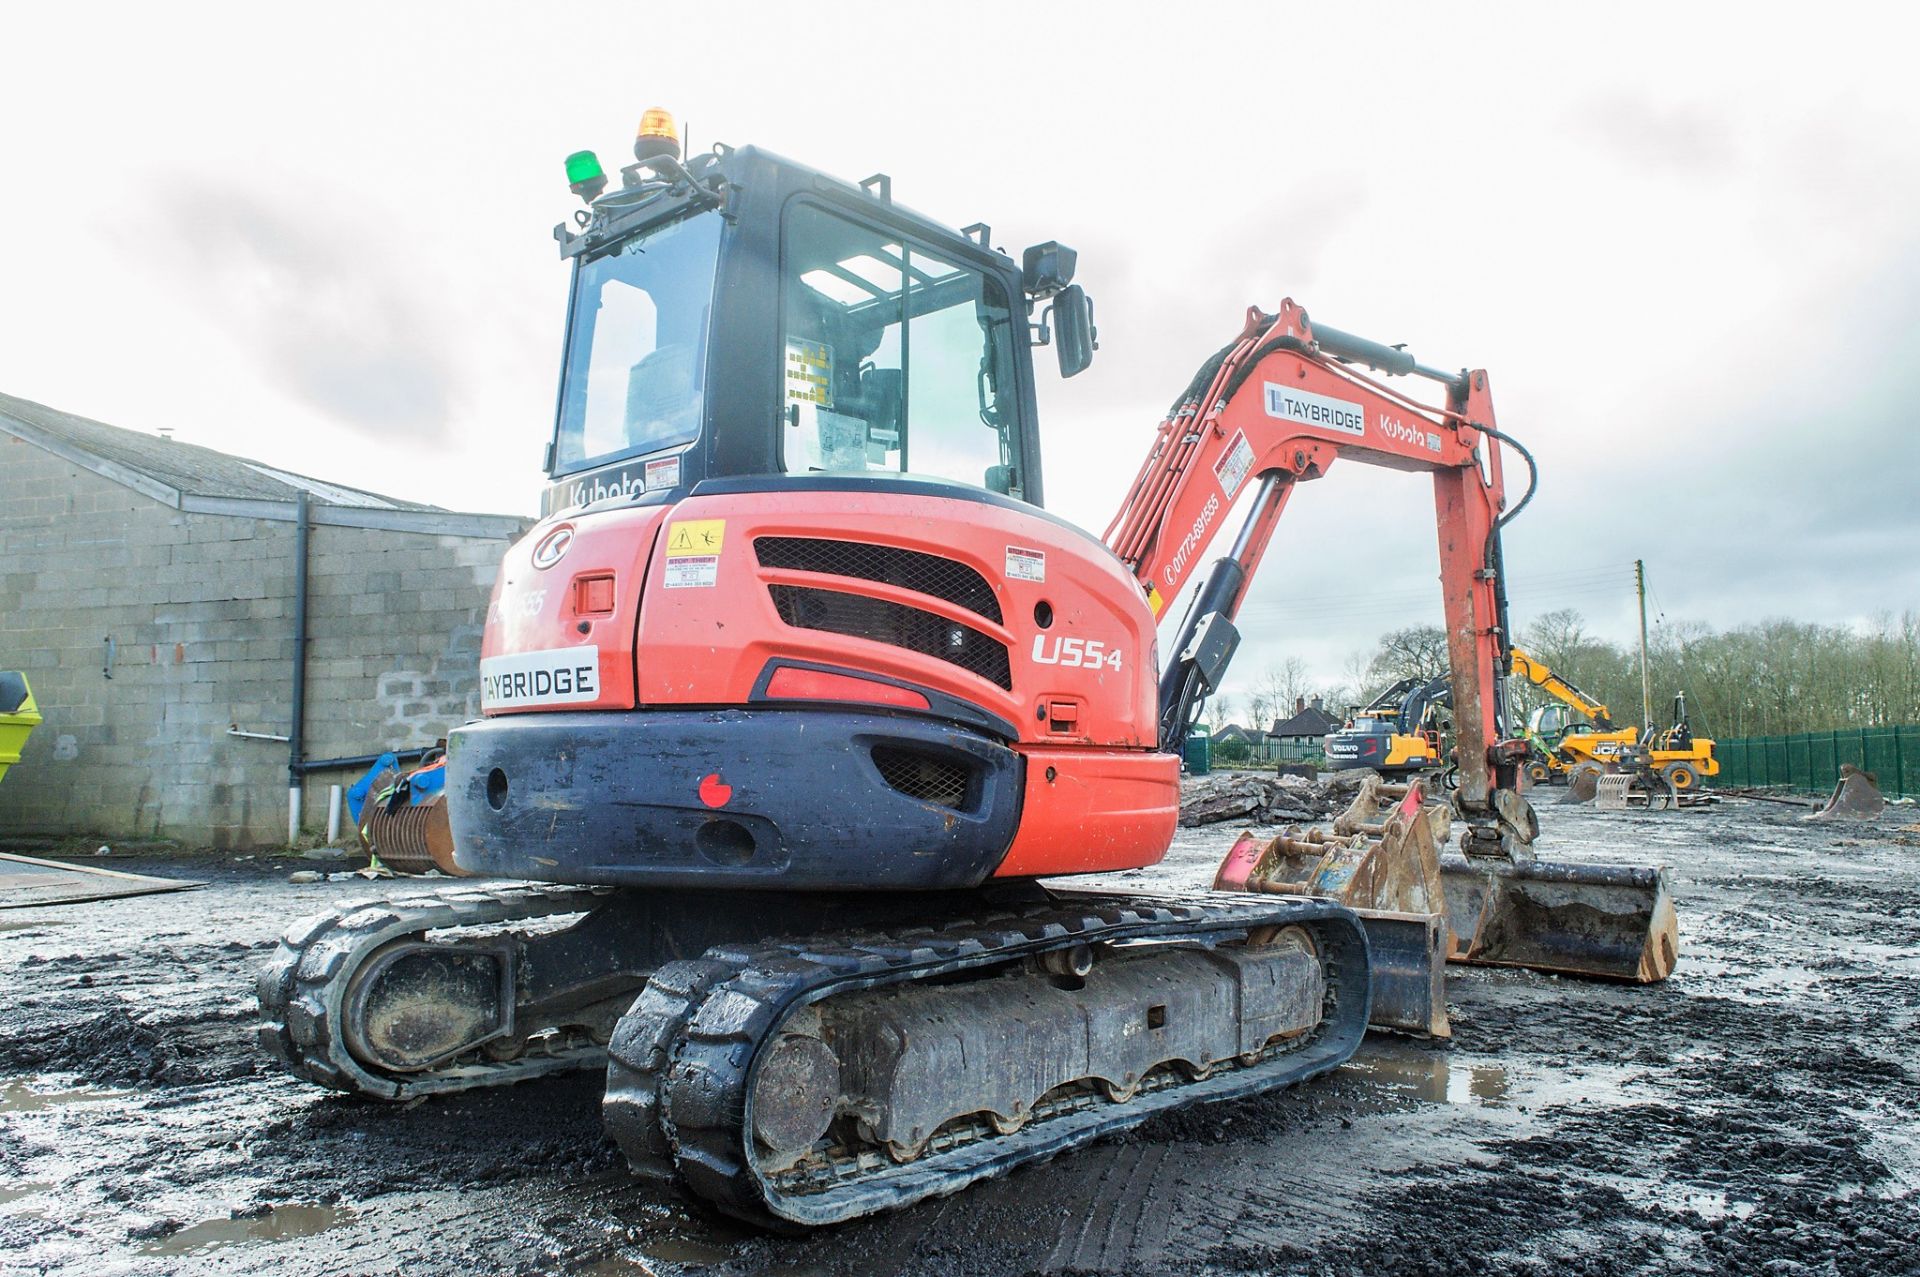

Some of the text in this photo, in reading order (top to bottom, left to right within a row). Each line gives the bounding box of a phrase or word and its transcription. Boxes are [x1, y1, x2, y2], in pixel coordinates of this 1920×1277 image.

[1284, 398, 1363, 432] TAYBRIDGE
[1380, 413, 1425, 447] Kubota
[570, 471, 645, 507] Kubota
[1174, 494, 1220, 573] 01772-691555
[483, 665, 594, 701] TAYBRIDGE
